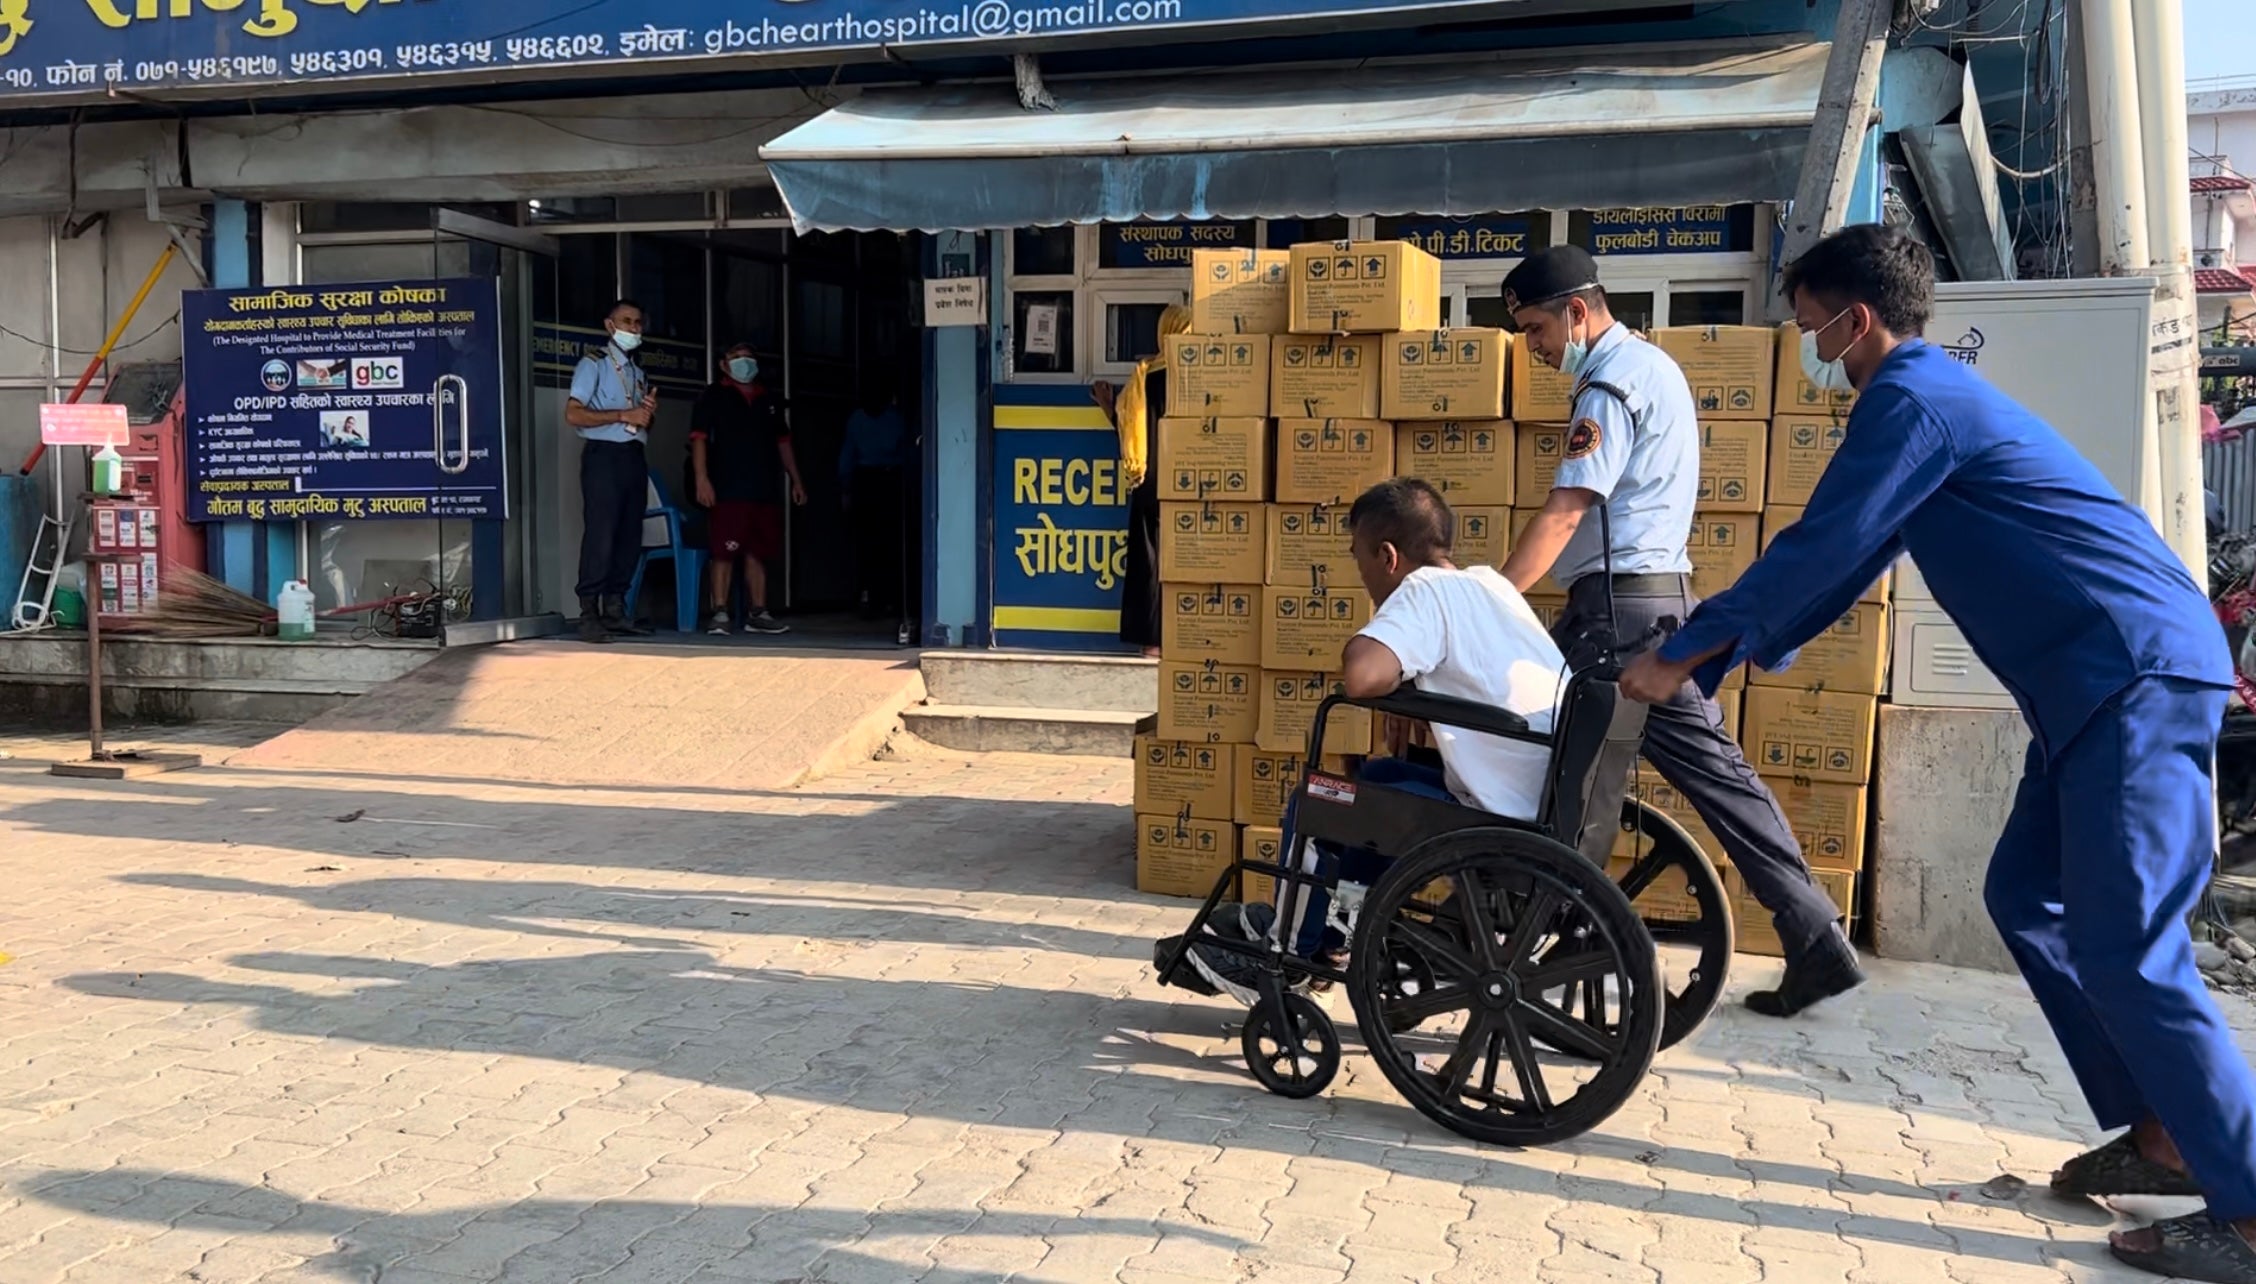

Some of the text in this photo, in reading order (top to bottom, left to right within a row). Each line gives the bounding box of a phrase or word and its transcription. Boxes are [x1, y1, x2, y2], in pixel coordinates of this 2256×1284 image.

[45, 59, 98, 85] फोन
[104, 58, 128, 82] नं.
[704, 0, 1182, 55] gbchearthospital@gmail.com
[1119, 225, 1235, 243] संस्थापक सदस्य
[228, 290, 314, 312] सामाजिक
[319, 289, 374, 311] सुरक्षा
[270, 332, 302, 344] Hospital
[313, 330, 341, 341] Provide
[343, 329, 374, 340] Medical
[376, 328, 415, 339] Treatment
[260, 345, 274, 355] The
[334, 341, 358, 352] Social
[360, 340, 390, 353] Security
[356, 360, 398, 386] gbc
[234, 394, 286, 410] OPD/IPD
[207, 495, 243, 515] गौतम
[269, 493, 339, 518] सामुदायिक
[368, 497, 427, 514] अस्पताल
